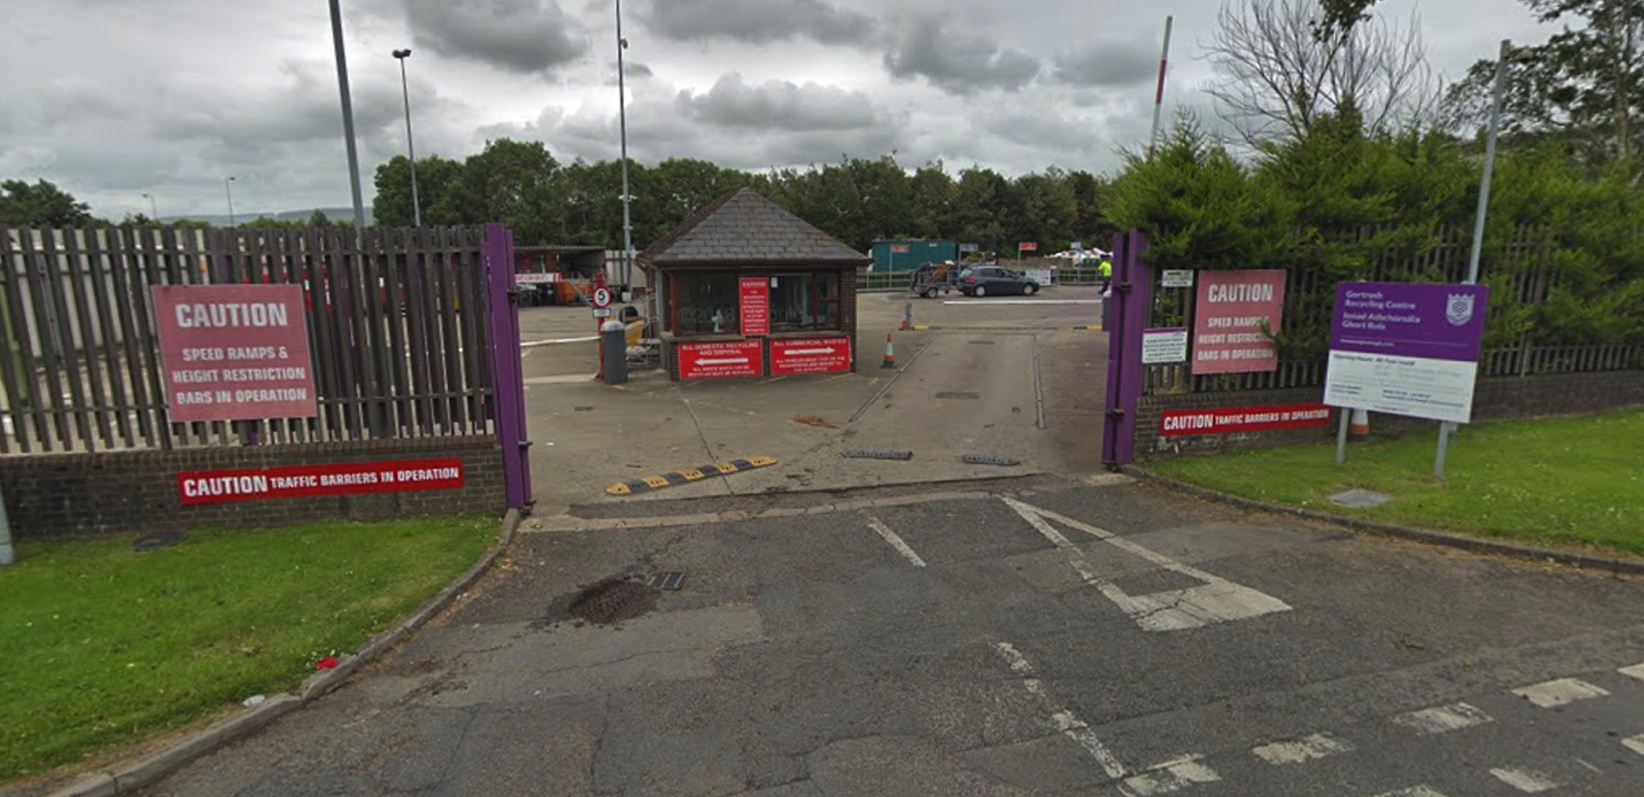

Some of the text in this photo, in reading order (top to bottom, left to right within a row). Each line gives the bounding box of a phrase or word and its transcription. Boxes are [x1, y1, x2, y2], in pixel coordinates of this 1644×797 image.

[598, 290, 606, 301] 5
[1208, 283, 1274, 302] CAUTION
[1345, 300, 1416, 309] Recycling Centre
[175, 303, 288, 328] CAUTION
[1207, 317, 1232, 328] SPEED
[1198, 334, 1226, 344] HEIGHT
[182, 346, 288, 361] SPEED RAMPS &
[1197, 348, 1274, 361] BARS IN OPERATION
[173, 367, 305, 382] HEIGHT RESTRICTION
[175, 388, 306, 405] BARS IN OPERATION
[1163, 409, 1330, 431] CAUTION TRAFFIC BARRIERS IN OPERATION
[183, 466, 459, 497] CAUTION TRAFFIC BARRIERS IN OPERATION
